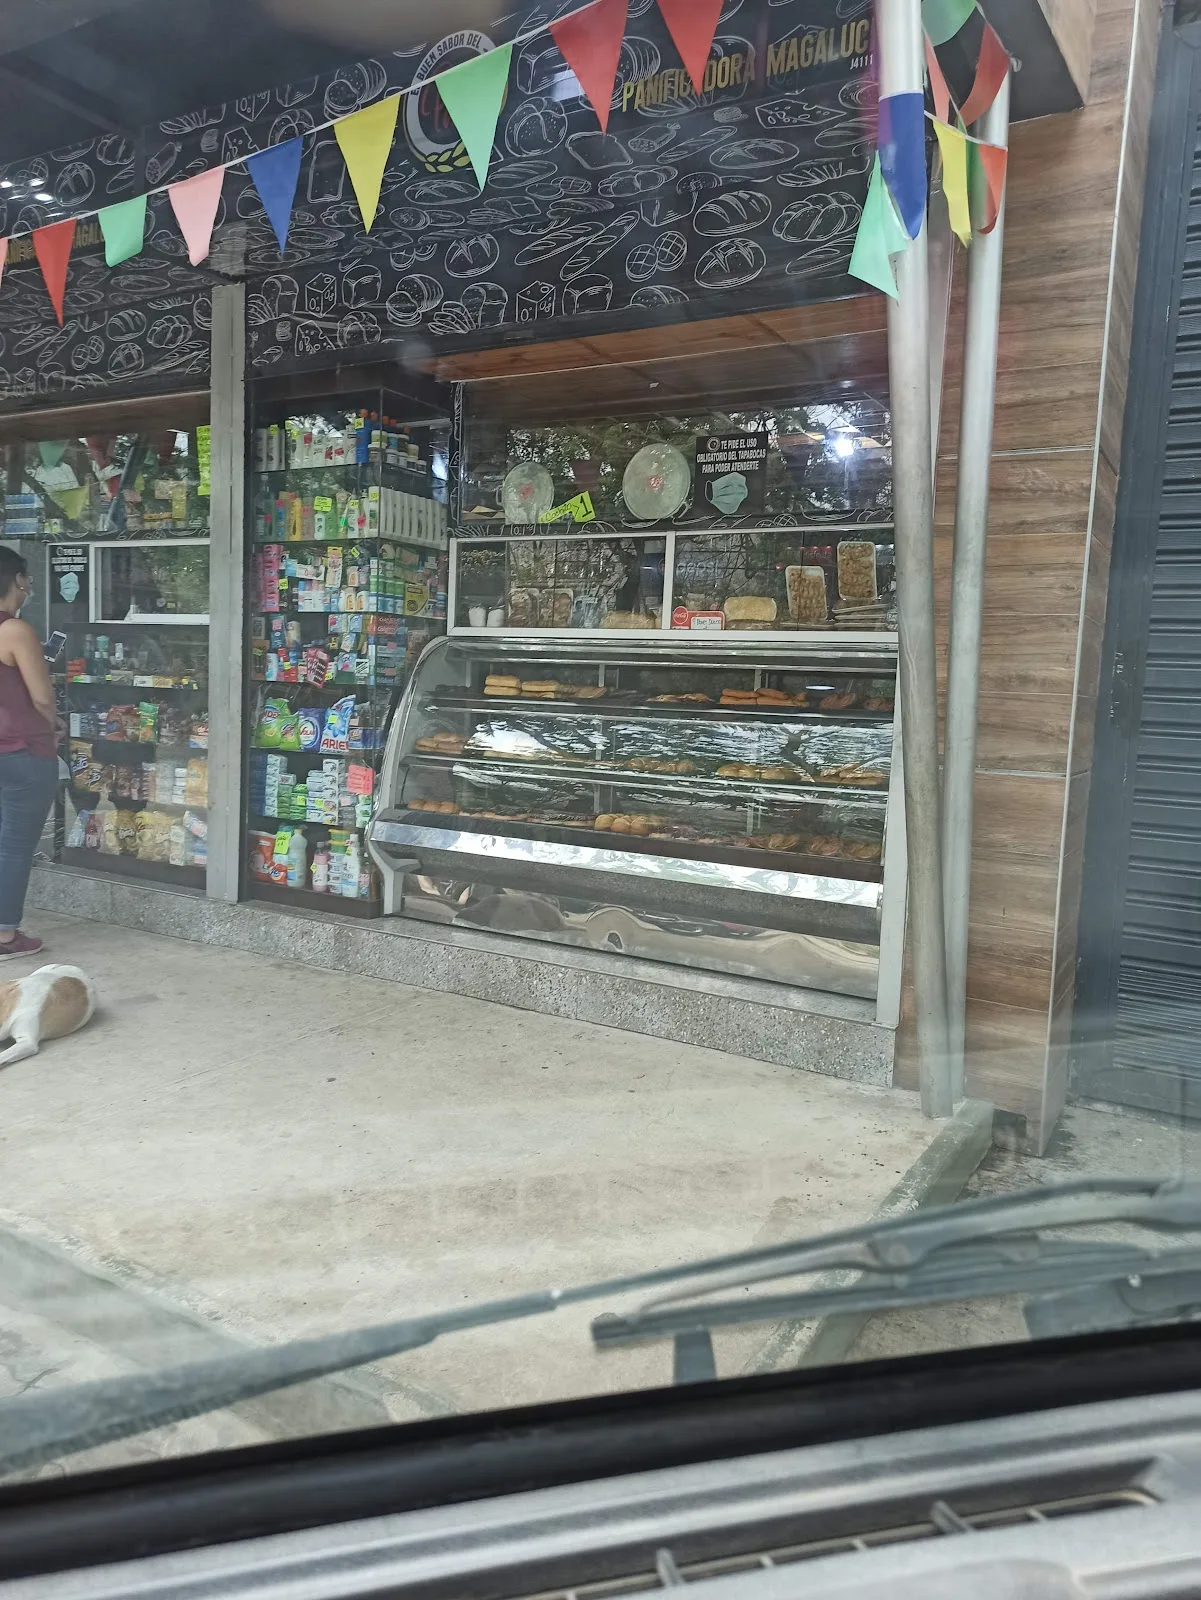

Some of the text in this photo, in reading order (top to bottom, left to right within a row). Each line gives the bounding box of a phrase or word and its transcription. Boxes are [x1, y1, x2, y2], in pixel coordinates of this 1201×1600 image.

[416, 52, 437, 81] BUEN
[436, 33, 465, 56] SABOR
[466, 33, 483, 49] DEL
[622, 18, 874, 113] PANIFICDORA MAGALUC
[720, 437, 758, 450] TE PIDE EL USO
[696, 448, 767, 463] OBLIGATORIO DEL TAPABOCAS
[701, 460, 760, 474] PARA PODER ATENDERTE
